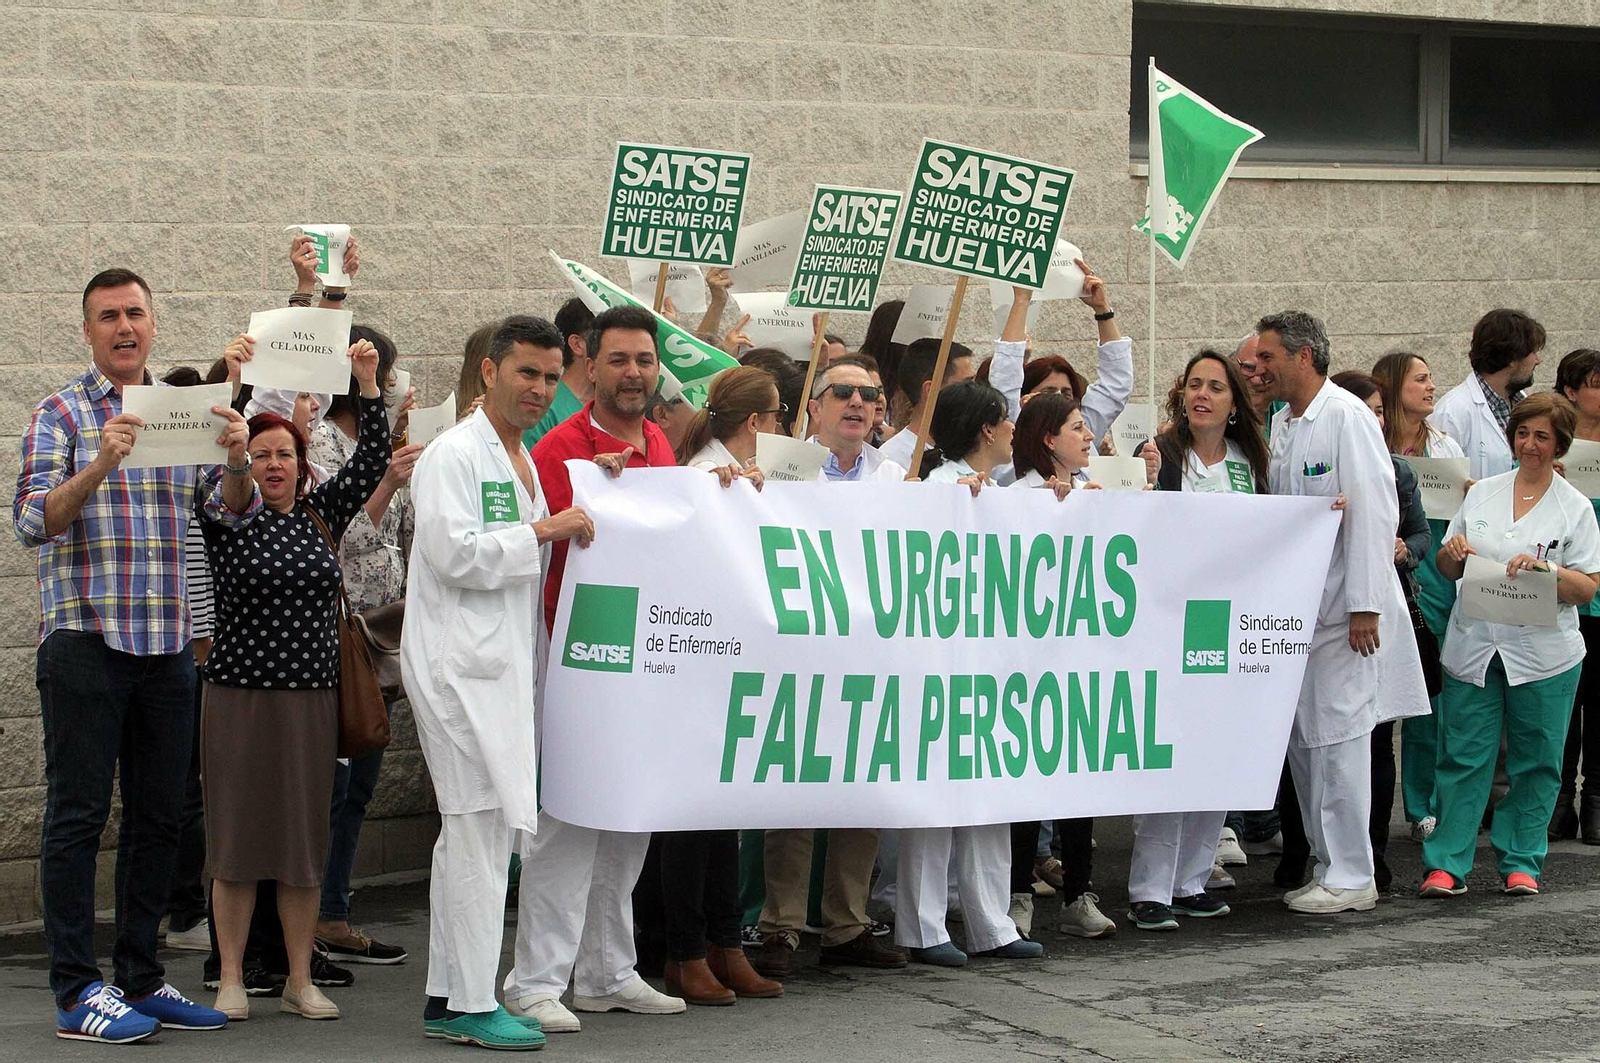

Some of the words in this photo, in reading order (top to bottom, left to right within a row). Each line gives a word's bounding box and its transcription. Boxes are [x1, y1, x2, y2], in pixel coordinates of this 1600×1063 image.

[619, 150, 744, 195] SATSE
[922, 148, 1067, 213] SATSE
[616, 188, 709, 211] SINDICATO
[713, 197, 737, 214] DE
[915, 188, 1021, 225] SINDICATO
[1025, 212, 1054, 233] DE
[613, 206, 733, 231] ENFERMERIA
[812, 193, 897, 237] SATSE
[910, 207, 1047, 251] ENFERMERIA
[610, 225, 728, 261] HUELVA
[753, 240, 771, 252] MAS
[806, 235, 866, 255] SINDICATO
[868, 240, 885, 257] DE
[741, 245, 787, 267] AUXILIARES
[801, 254, 878, 275] ENFERMERIA
[904, 227, 1038, 283] HUELVA
[798, 274, 871, 307] HUELVA
[757, 318, 805, 328] ENFERMERAS
[773, 309, 789, 317] MAS
[292, 331, 315, 341] MAS
[270, 341, 334, 355] CELADORES
[169, 410, 191, 420] MAS
[143, 421, 212, 431] ENFERMERAS
[1120, 479, 1132, 487] MAS
[1419, 482, 1451, 490] ADORES
[1422, 473, 1440, 481] MAS
[758, 525, 850, 637] EN
[861, 528, 1138, 640] URGENCIAS
[1499, 583, 1518, 592] MAS
[1480, 587, 1538, 600] ENFERMERAS
[648, 604, 713, 628] Sindicato
[1239, 614, 1303, 632] Sindicato
[569, 641, 631, 665] SATSE
[646, 633, 664, 653] de
[669, 634, 742, 657] Enfermería
[1239, 638, 1257, 655] de
[643, 660, 676, 676] Huelva
[1186, 650, 1226, 667] SATSE
[1238, 662, 1270, 674] Huelva
[719, 671, 901, 783] FALTA
[917, 670, 1173, 781] PERSONAL
